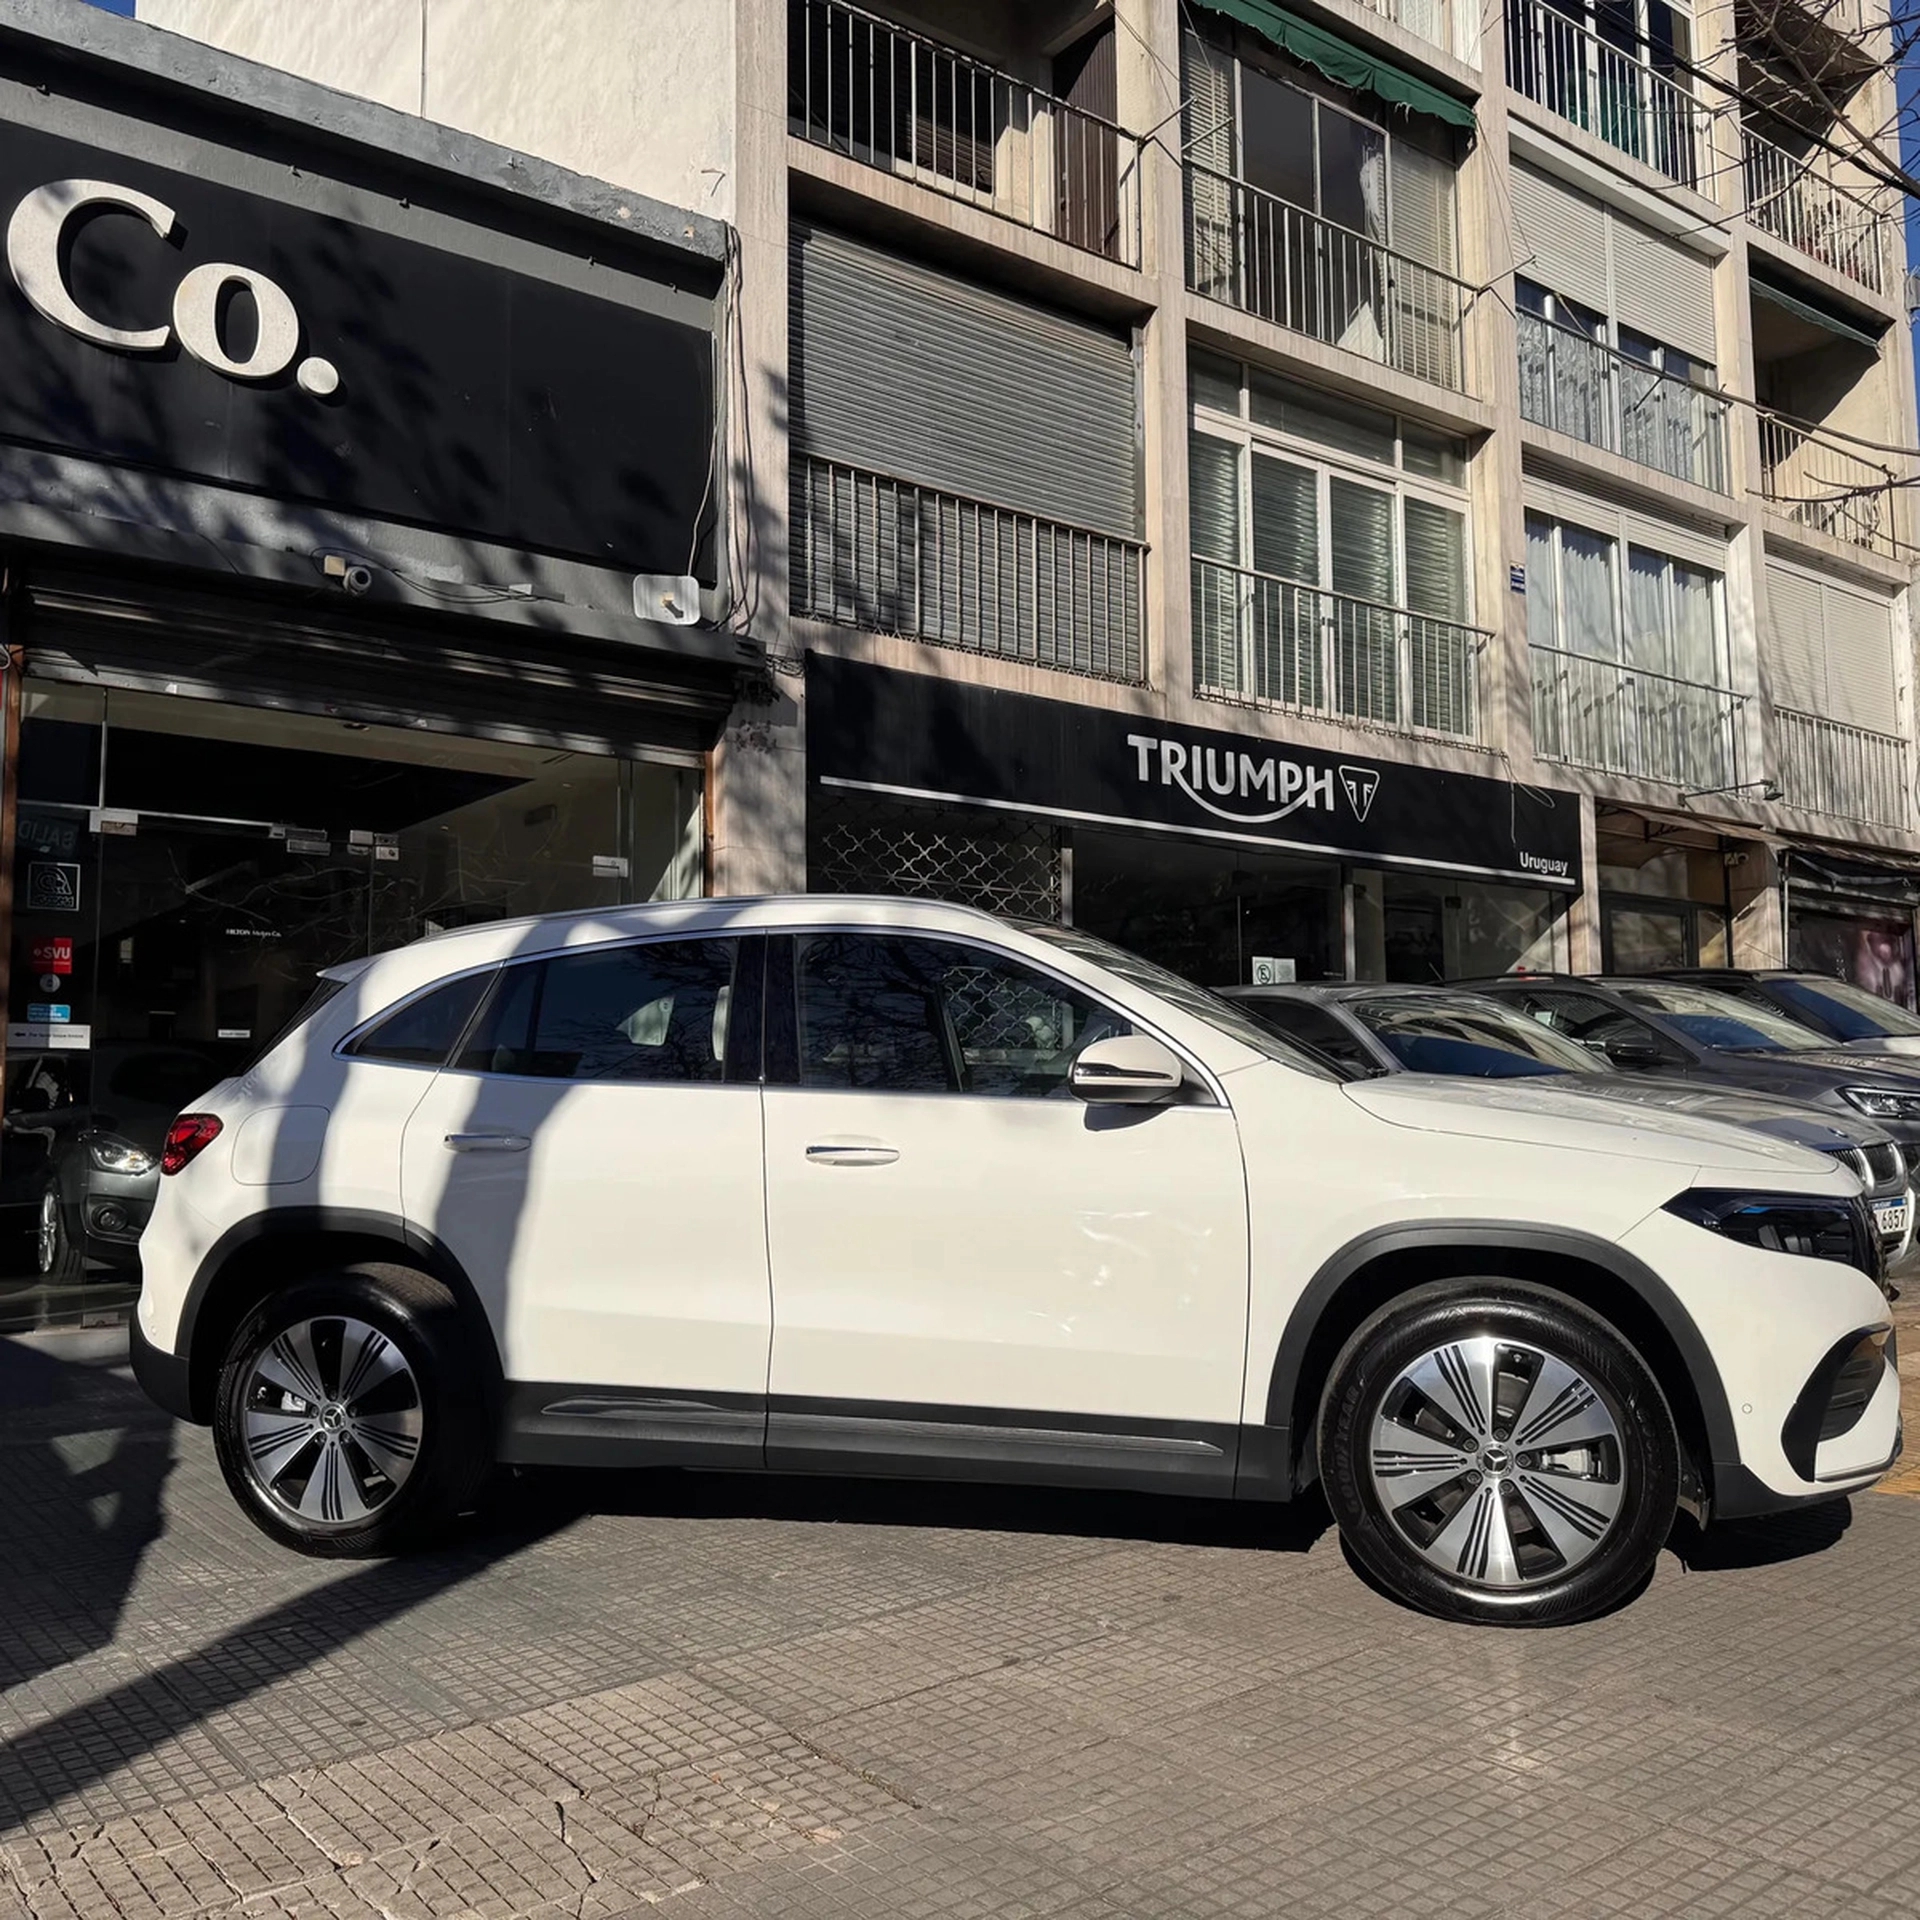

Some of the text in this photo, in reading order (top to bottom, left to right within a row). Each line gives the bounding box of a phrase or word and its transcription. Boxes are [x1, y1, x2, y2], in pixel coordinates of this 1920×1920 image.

[7, 179, 339, 395] Co.
[1127, 734, 1334, 823] TRIUMPH
[1520, 851, 1568, 876] Uruguay
[42, 946, 71, 960] SVU
[1881, 1208, 1906, 1230] 6857
